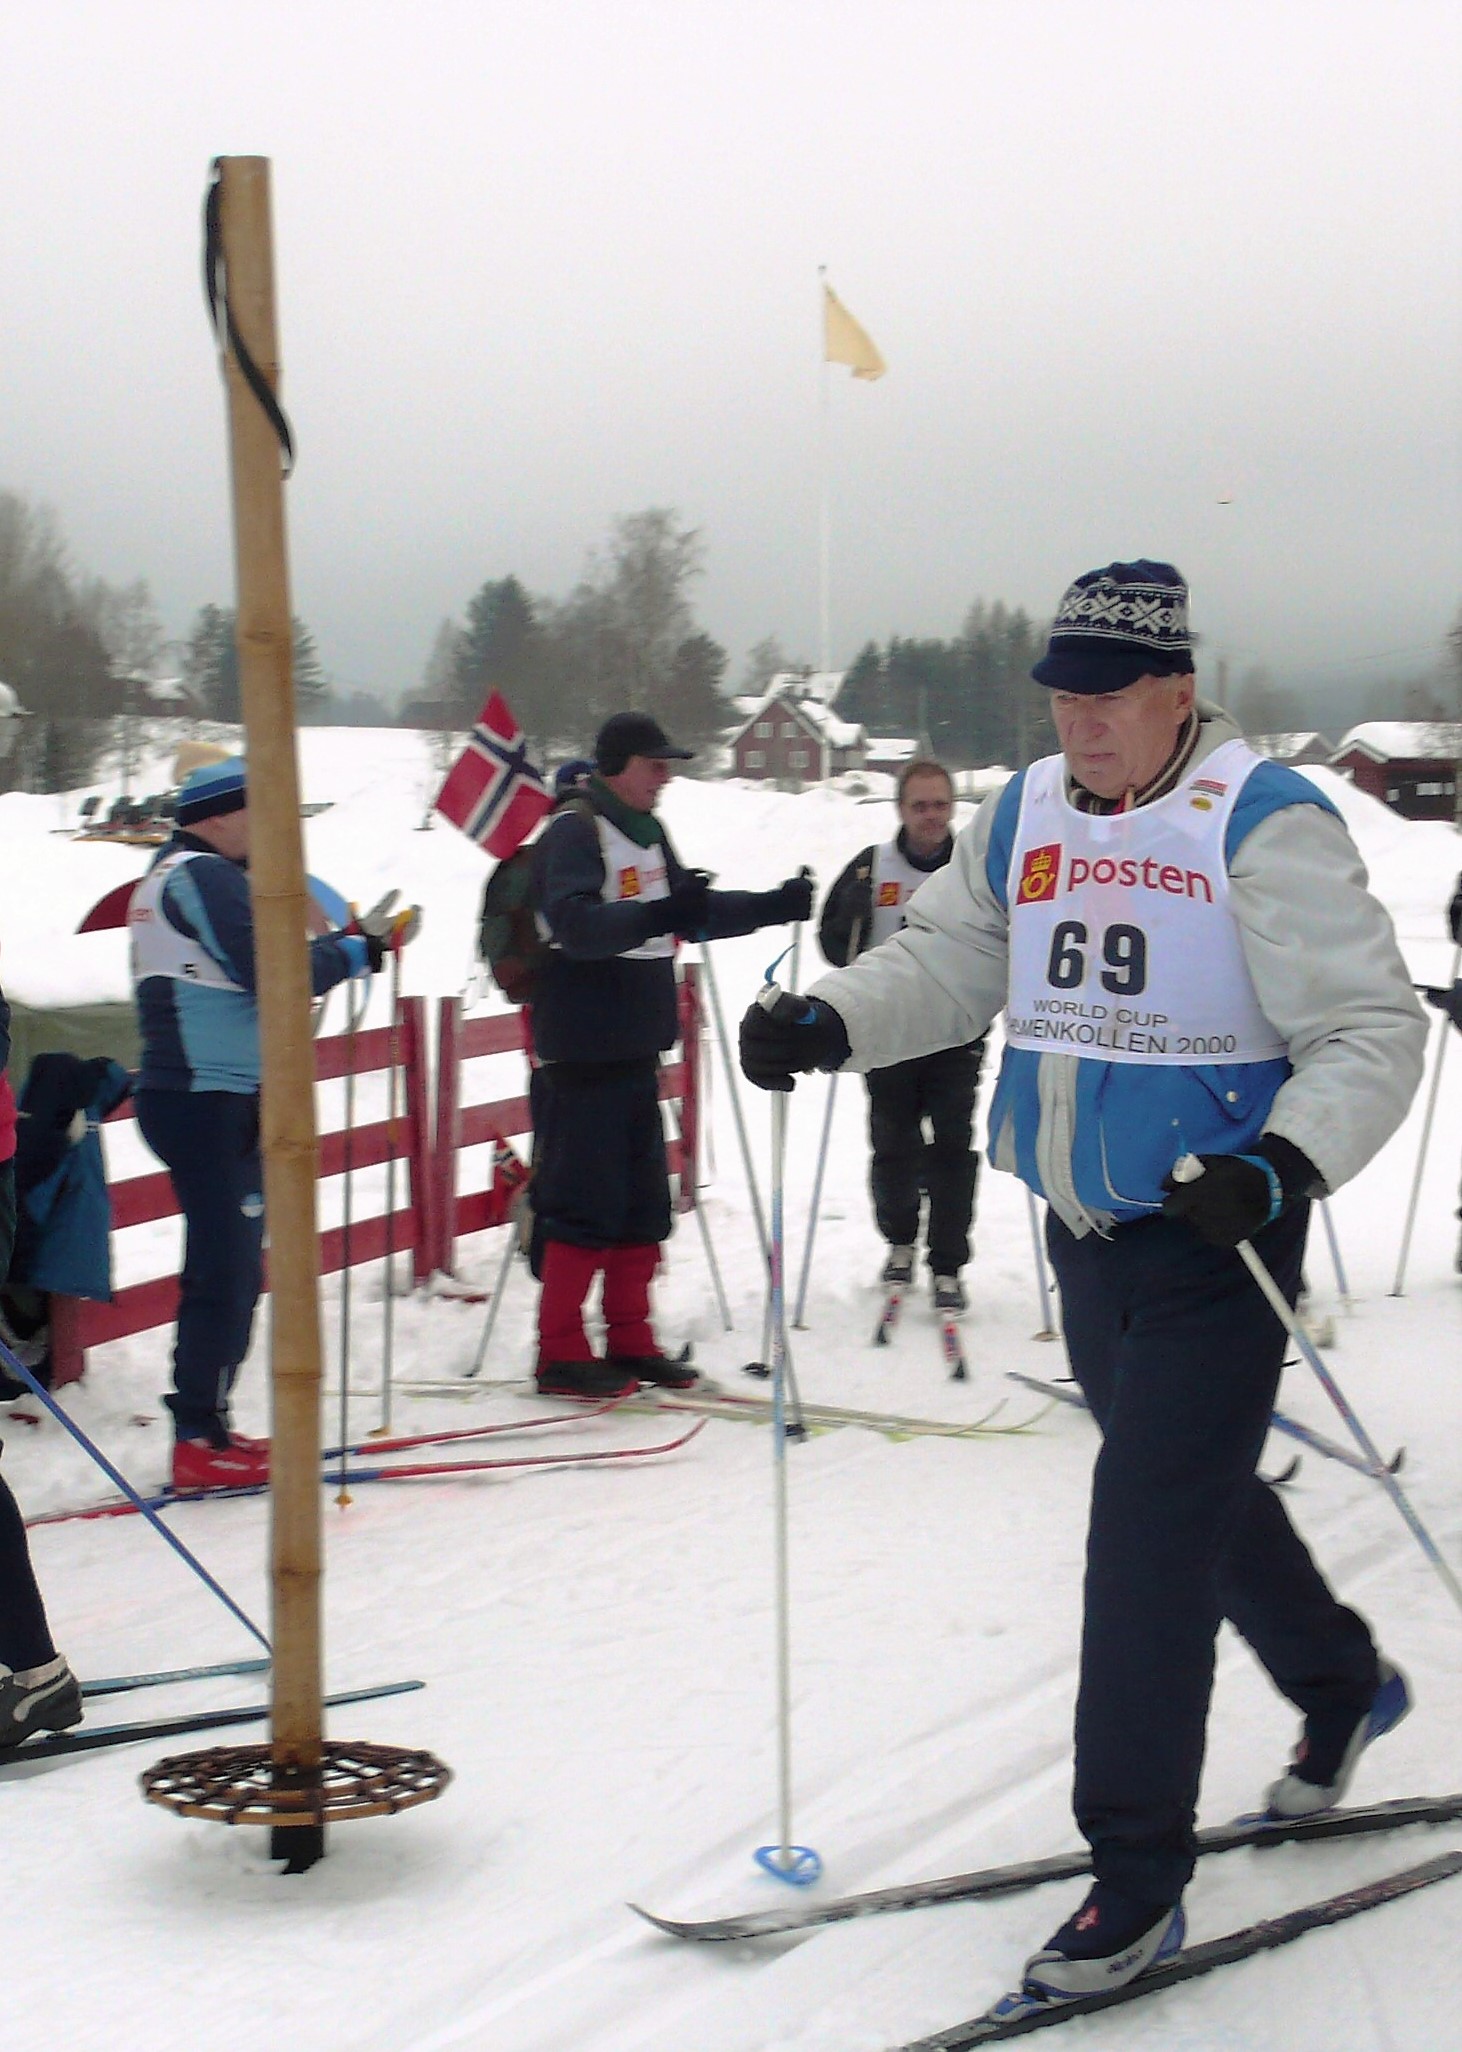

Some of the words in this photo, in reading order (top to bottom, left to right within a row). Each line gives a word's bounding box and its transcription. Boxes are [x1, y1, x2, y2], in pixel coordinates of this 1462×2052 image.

[1068, 857, 1213, 903] posten
[1047, 920, 1147, 996] 69
[1033, 999, 1107, 1020] WORLD
[1116, 1008, 1168, 1028] CUP
[1177, 1035, 1237, 1054] 2000
